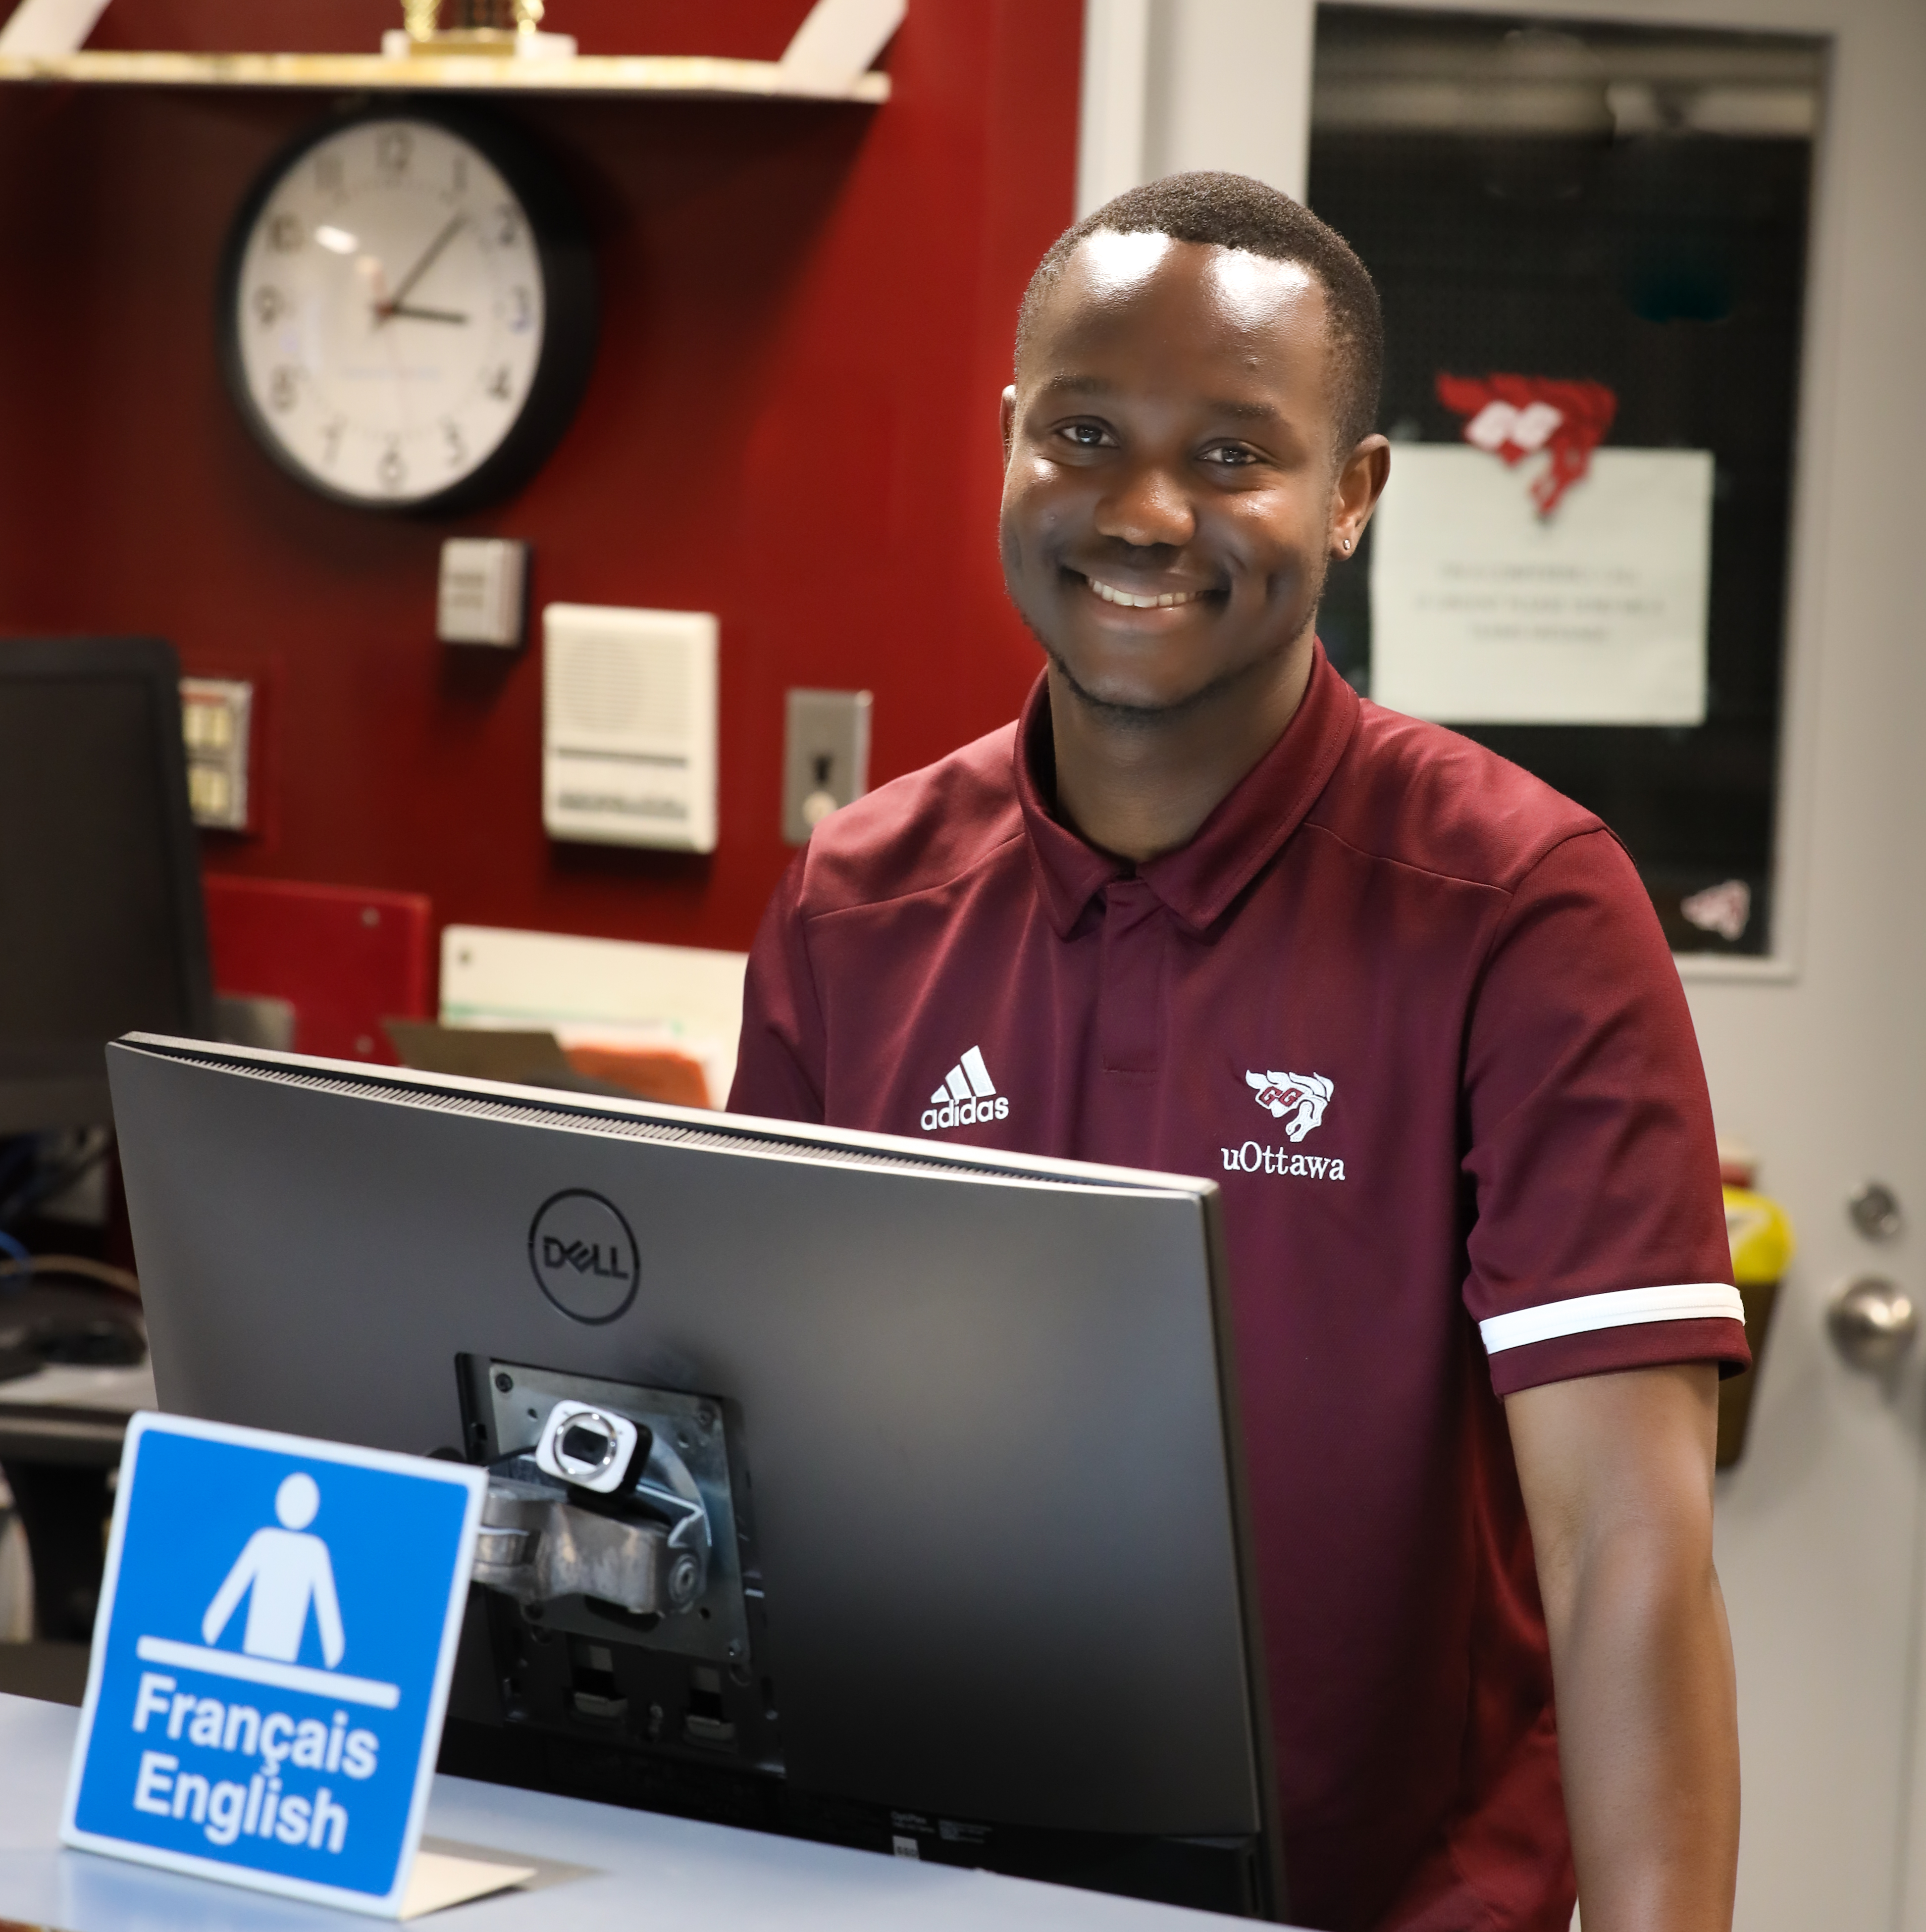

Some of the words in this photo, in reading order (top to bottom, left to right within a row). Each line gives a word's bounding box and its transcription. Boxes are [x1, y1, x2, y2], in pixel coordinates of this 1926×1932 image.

[921, 1095, 1009, 1130] adidas
[1221, 1141, 1346, 1180] uOttawa
[543, 1236, 629, 1279] DELL
[132, 1672, 379, 1779] Français
[133, 1750, 349, 1854] English
